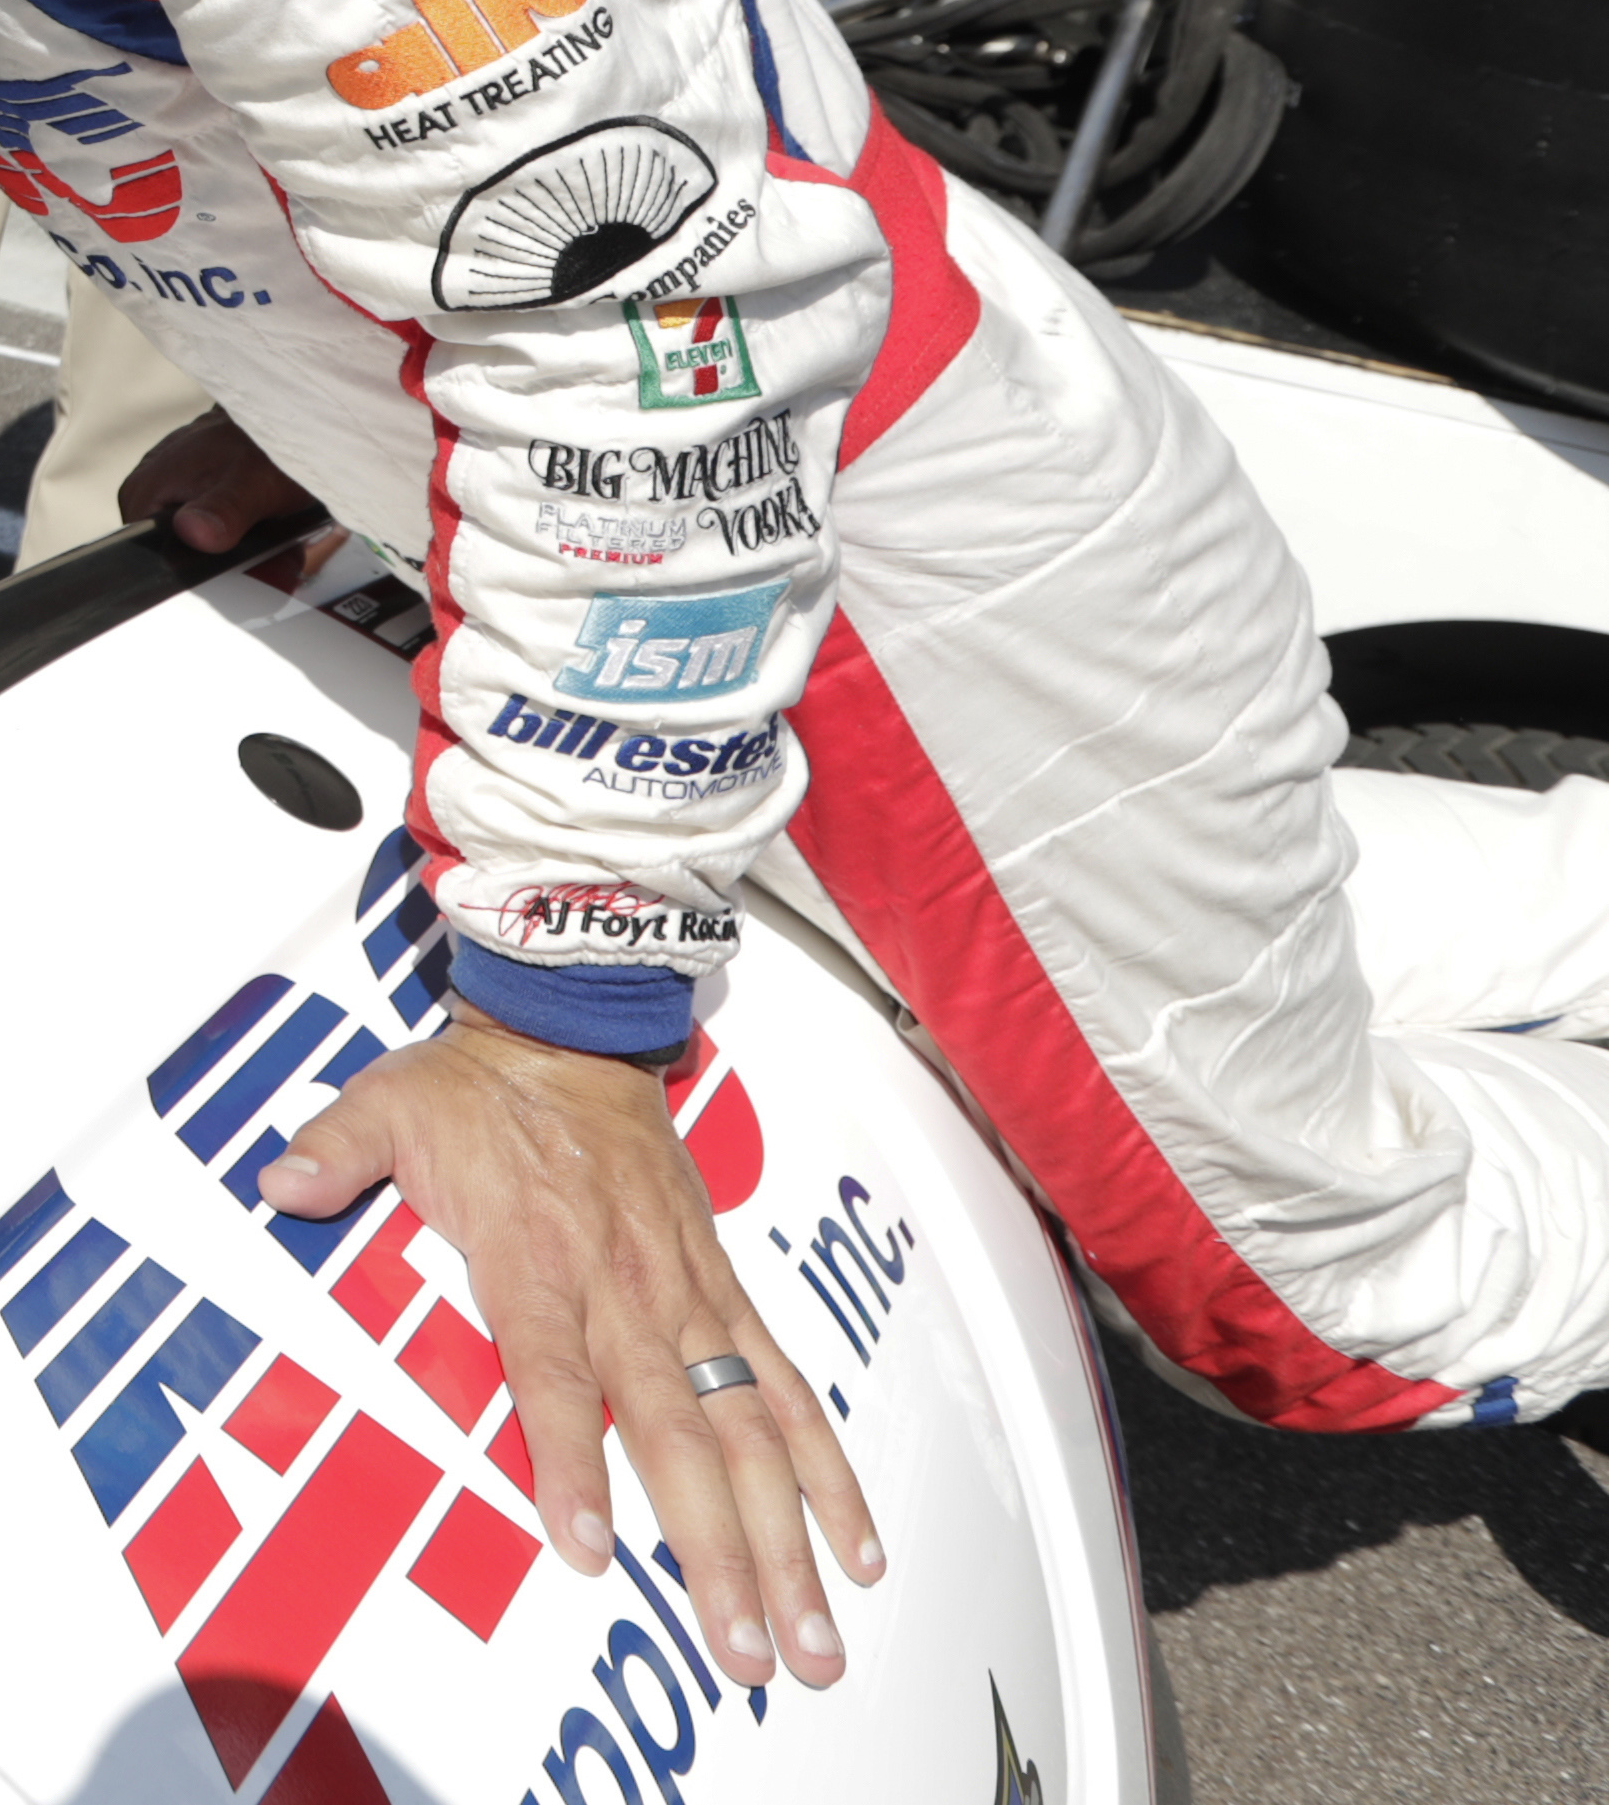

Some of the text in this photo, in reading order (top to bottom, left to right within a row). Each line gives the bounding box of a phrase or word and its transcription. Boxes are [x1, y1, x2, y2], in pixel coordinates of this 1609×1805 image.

[364, 6, 614, 151] HEAT TREATING
[131, 251, 273, 309] inc.
[528, 408, 800, 502] BIG MACHINE
[535, 520, 686, 553] FILTERED
[539, 501, 686, 539] PLATINUM
[697, 477, 821, 556] VODKA
[559, 542, 663, 565] PREMIUM
[594, 619, 758, 689] ism
[487, 693, 620, 760] bill
[583, 755, 783, 801] AUTOMOTIVE
[525, 896, 570, 936] AJ
[580, 903, 667, 946] Foyt
[769, 1175, 917, 1371] inc.
